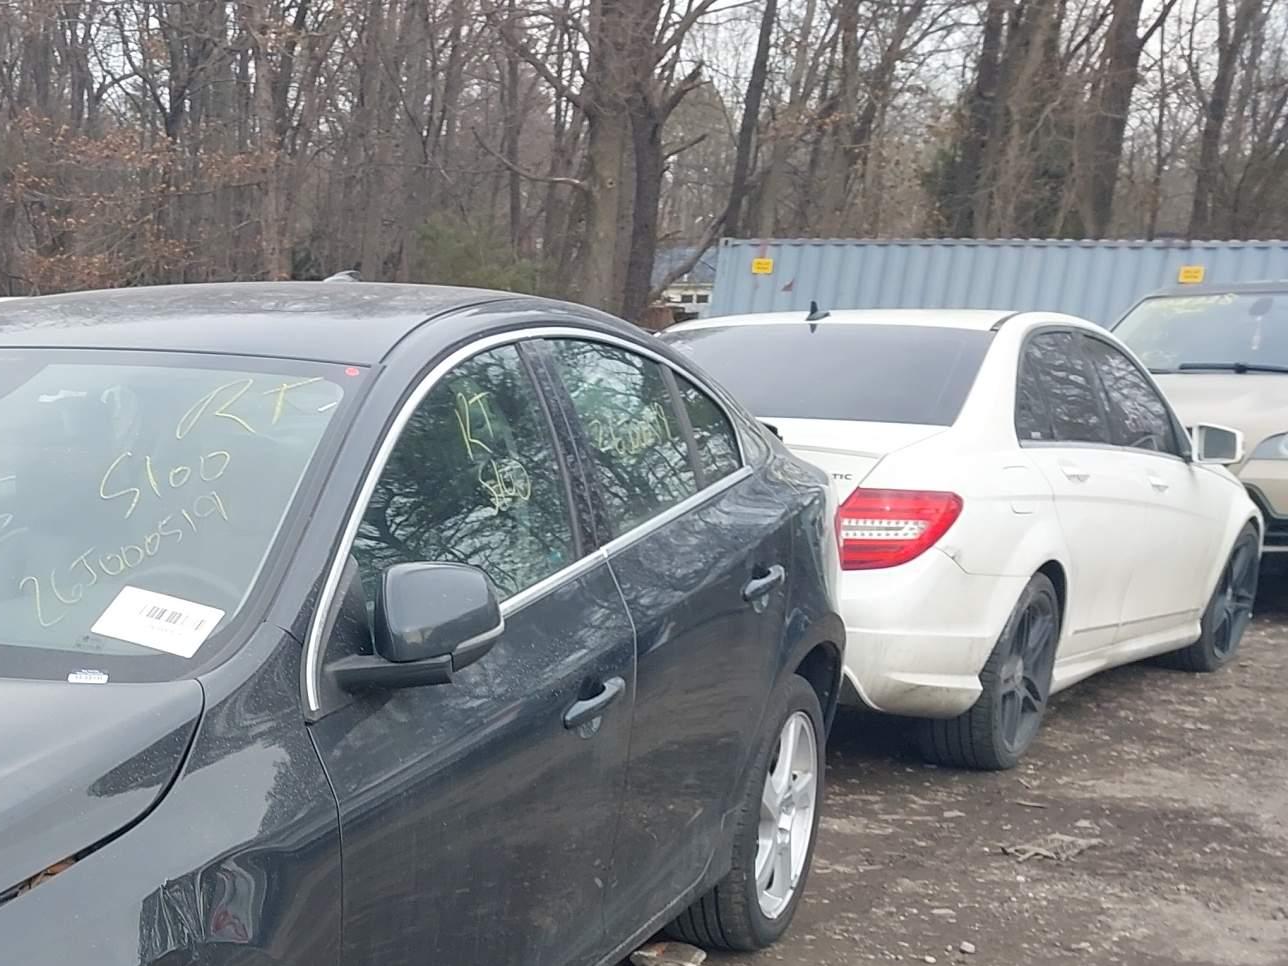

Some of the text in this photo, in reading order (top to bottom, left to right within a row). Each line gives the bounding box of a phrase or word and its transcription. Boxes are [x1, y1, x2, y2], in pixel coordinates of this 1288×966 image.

[175, 376, 325, 439] RT
[454, 392, 493, 461] RT
[99, 450, 231, 519] S100
